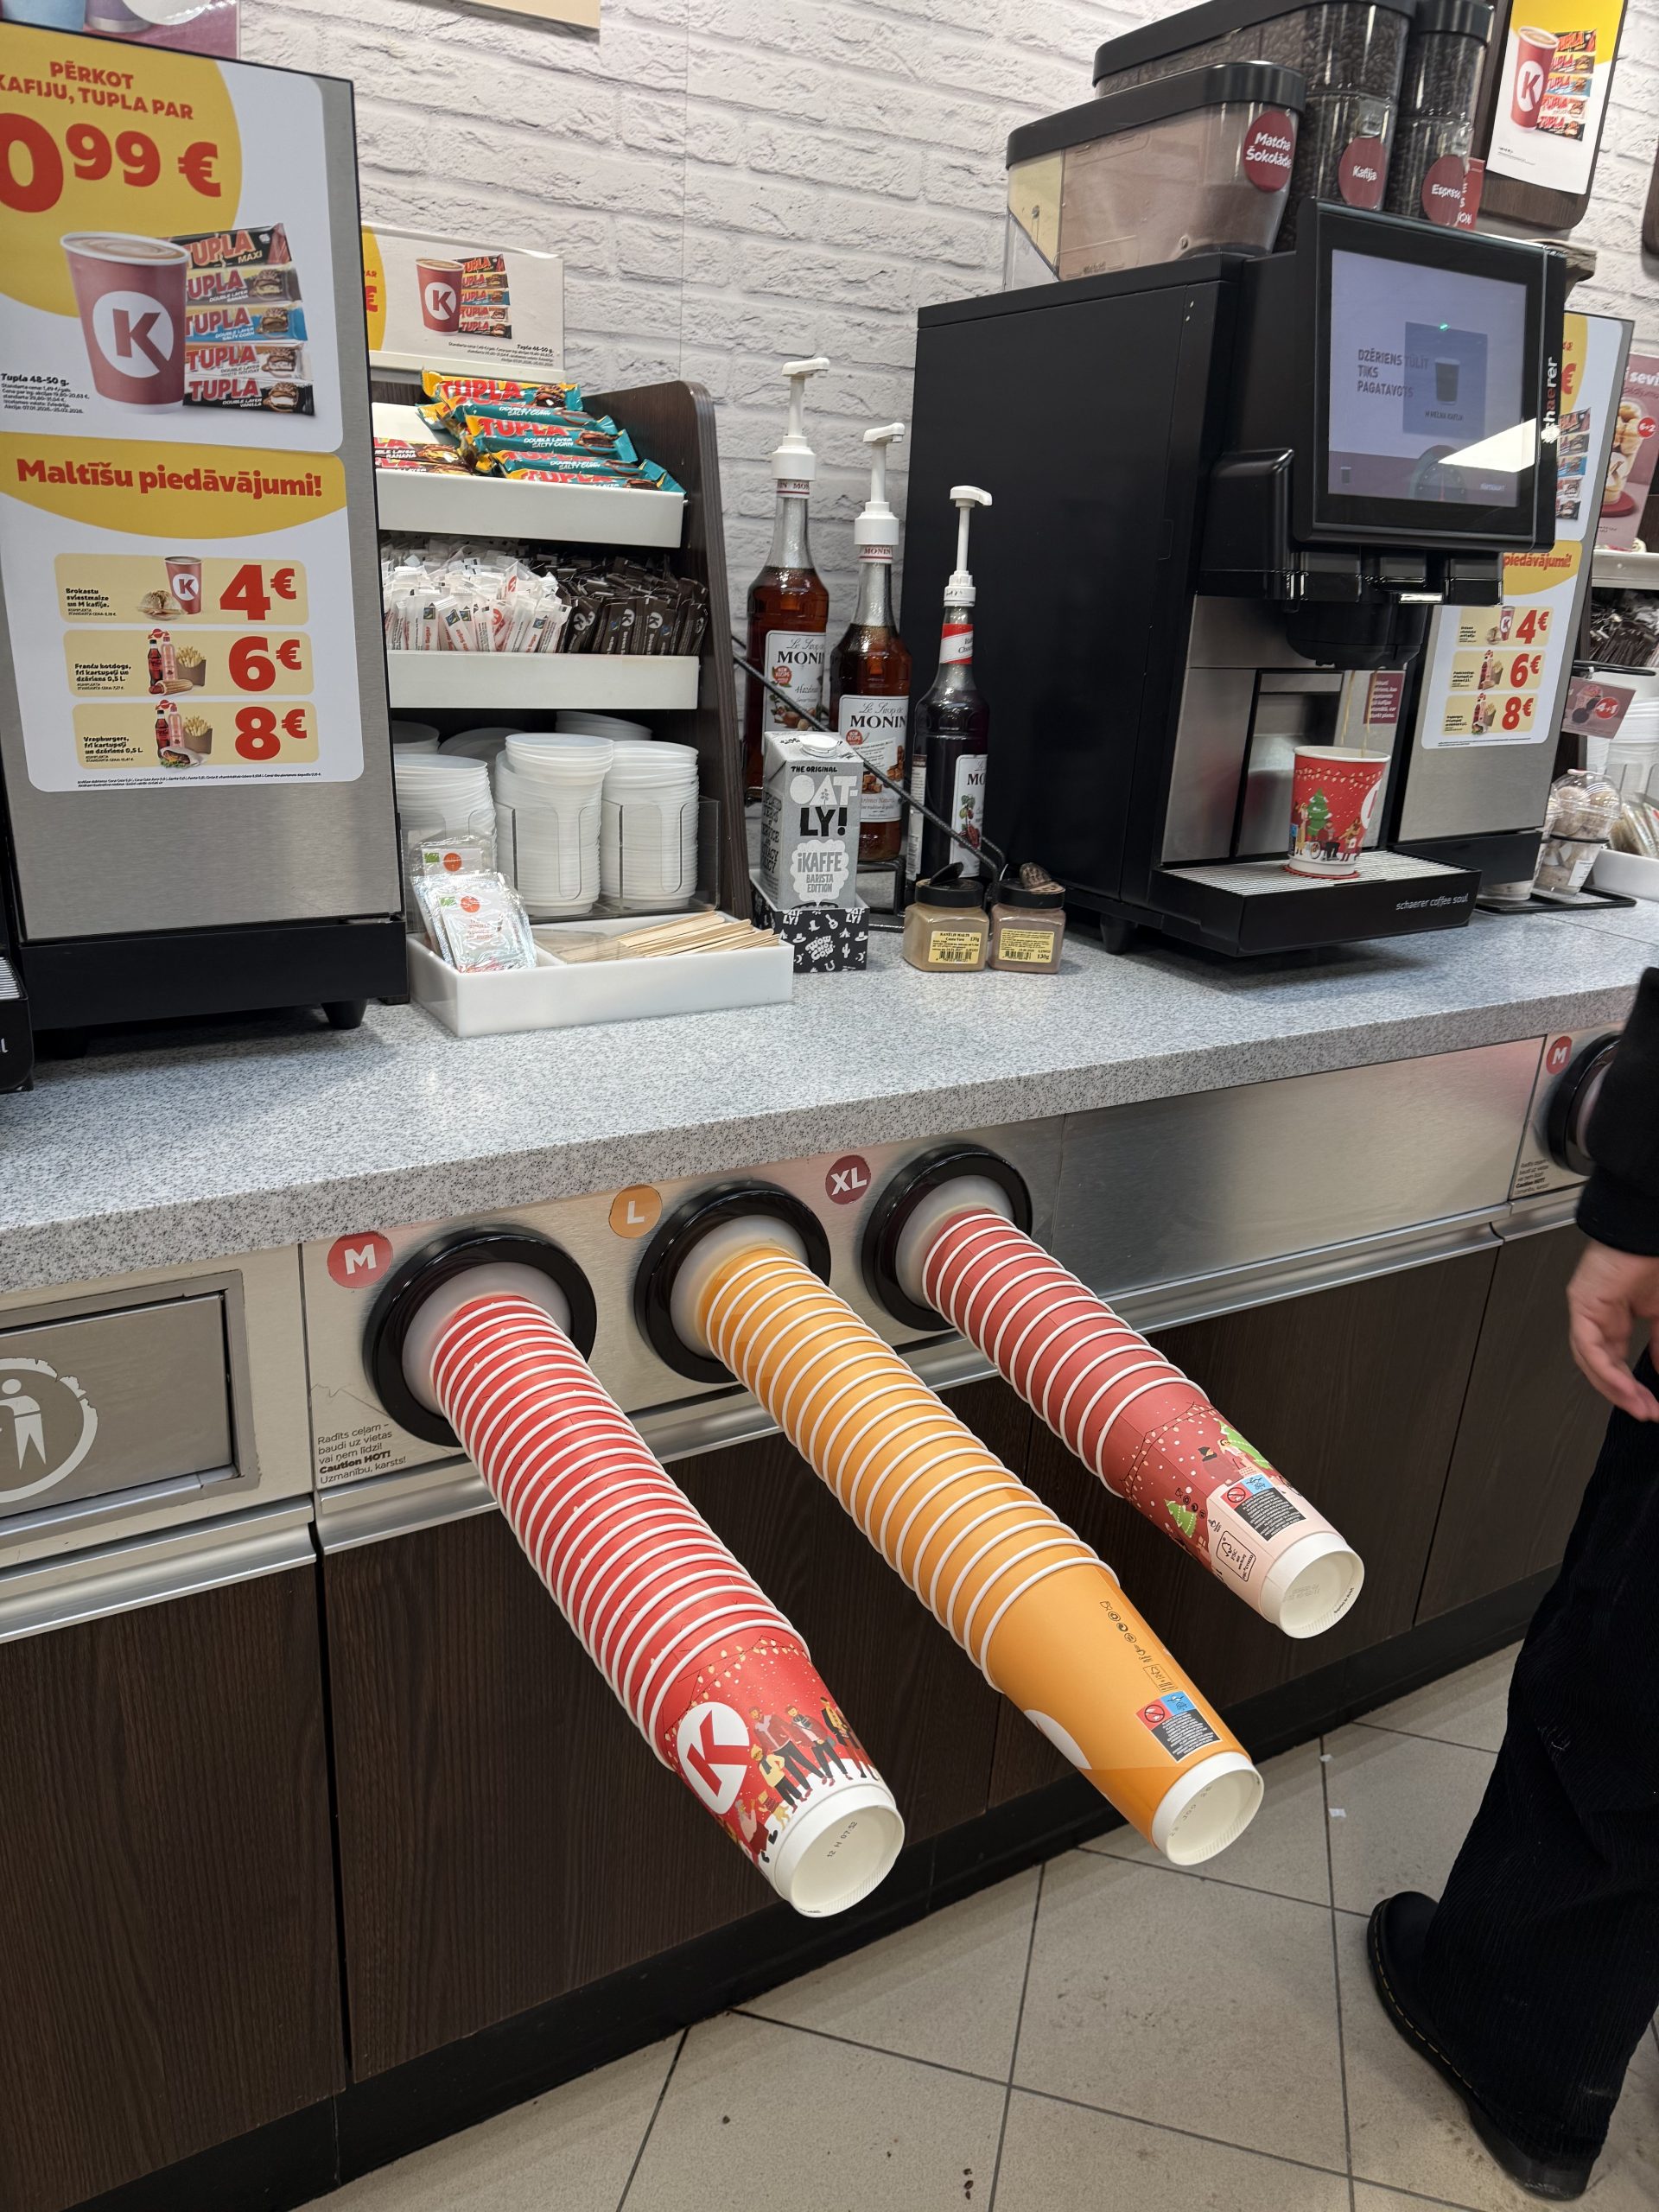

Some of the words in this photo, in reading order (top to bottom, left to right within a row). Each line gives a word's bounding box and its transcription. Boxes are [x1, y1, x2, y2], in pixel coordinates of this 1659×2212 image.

[49, 60, 134, 89] PĒRKOT
[1521, 71, 1541, 105] K
[78, 87, 148, 113] TUPLA
[152, 99, 194, 120] PAR
[1255, 132, 1291, 151] Matcha
[177, 142, 221, 198] €
[238, 251, 263, 264] MAXI
[186, 270, 246, 299] UPLA
[364, 270, 377, 278] AR
[432, 289, 455, 318] K
[112, 308, 170, 363] K
[187, 346, 257, 372] TUPLA
[1357, 348, 1402, 365] DZĒRIENS
[1, 373, 28, 383] Tupla
[1357, 365, 1378, 378] TIKS
[189, 378, 262, 402] TUPLA
[442, 380, 523, 400] TUPLA
[1357, 380, 1414, 397] PAGATAVOTS
[1543, 356, 1558, 439] chaerer
[477, 417, 569, 437] TUPLA
[16, 459, 133, 488] Maltīšu
[139, 465, 322, 499] piedāvājumi!
[179, 579, 195, 596] K
[777, 651, 825, 664] MONI
[850, 715, 906, 728] MONIN
[799, 806, 848, 837] LY!
[798, 851, 842, 873] iKAFFE
[806, 874, 834, 883] BARISTA
[807, 883, 832, 893] EDITION
[1396, 899, 1429, 910] schaerer
[1430, 896, 1452, 906] coffee
[1452, 893, 1469, 904] soul
[1552, 1046, 1568, 1065] M
[830, 1166, 868, 1196] XL
[626, 1201, 645, 1224] L
[344, 1243, 378, 1275] M
[318, 1432, 349, 1445] Radīts
[352, 1424, 381, 1437] ceļam
[319, 1442, 346, 1455] baudi
[349, 1439, 360, 1447] uz
[364, 1431, 392, 1443] vietas
[319, 1456, 334, 1465] vai
[336, 1451, 358, 1462] ņem
[360, 1442, 382, 1454] līdzi!
[319, 1459, 361, 1474] Caution
[364, 1450, 391, 1464] HOT!
[321, 1466, 373, 1484] Uzmanību,
[375, 1456, 406, 1470] karsts!
[686, 1709, 749, 1797] K
